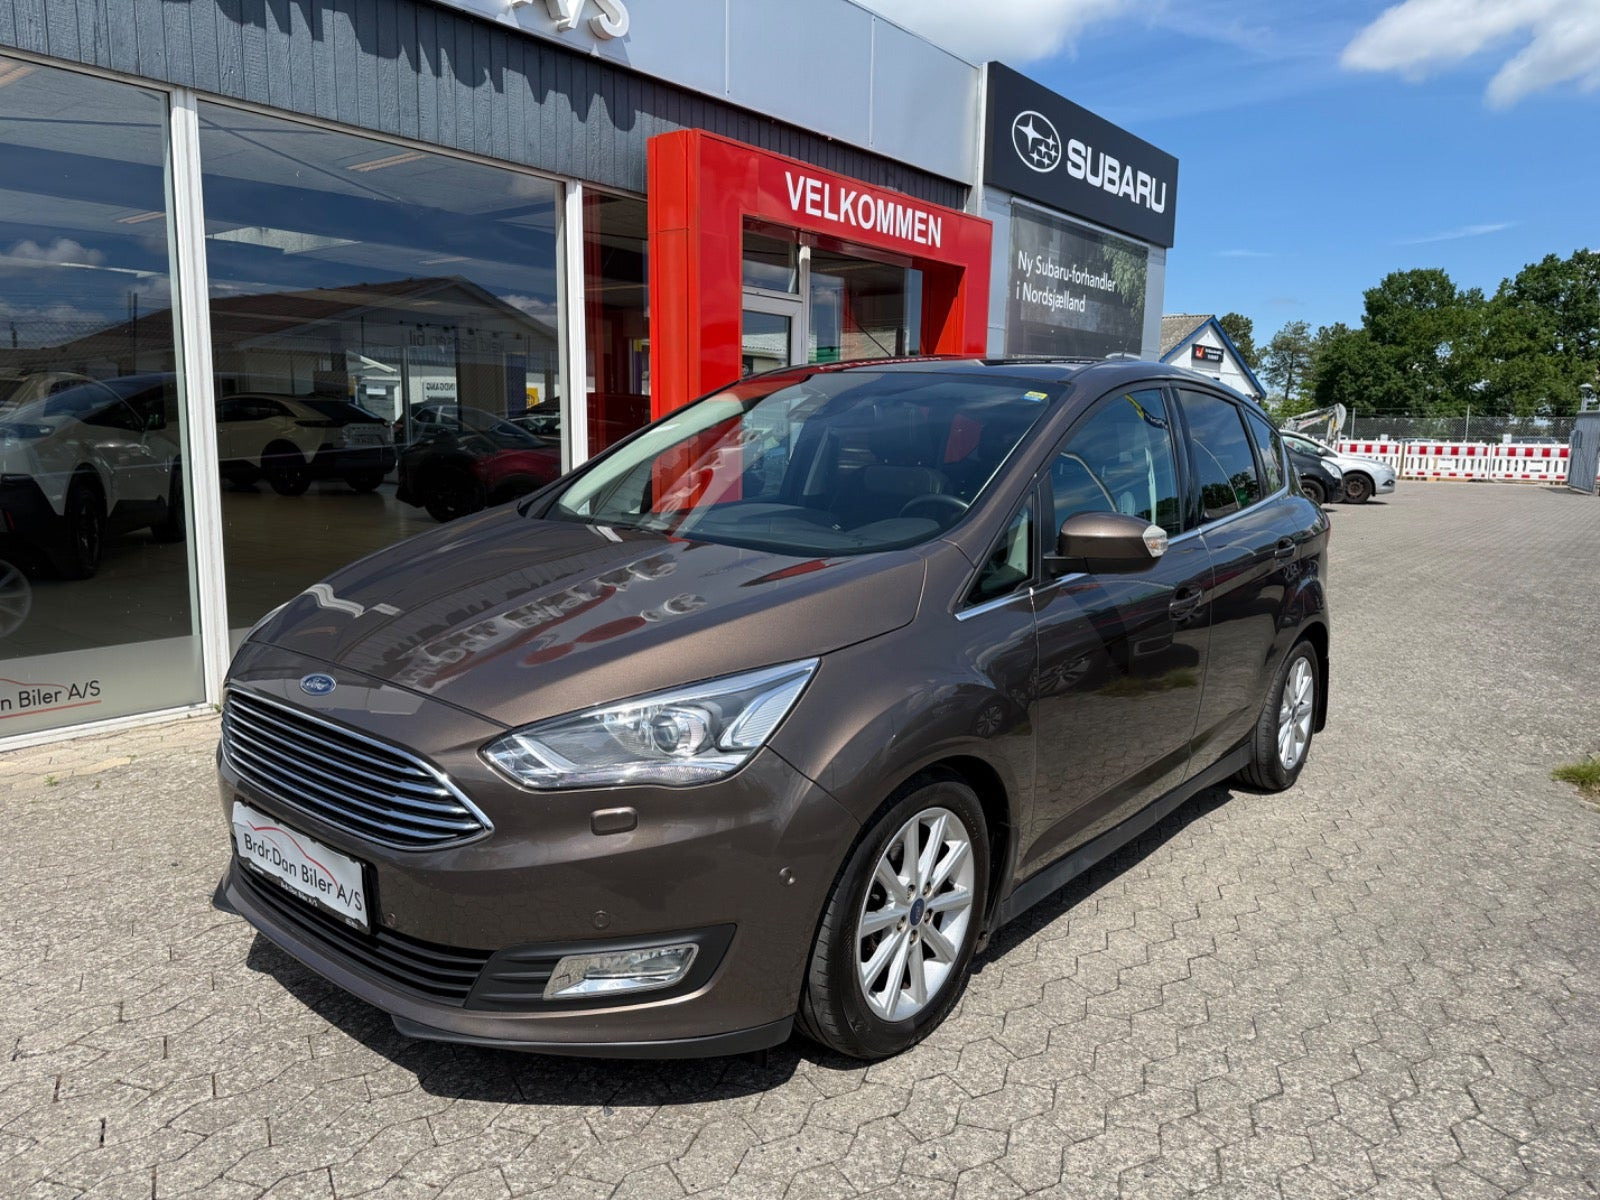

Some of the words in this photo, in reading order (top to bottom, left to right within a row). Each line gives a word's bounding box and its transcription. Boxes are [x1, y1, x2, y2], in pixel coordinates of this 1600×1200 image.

[1067, 138, 1166, 214] SUBARU
[785, 171, 942, 248] VELKOMMEN
[1016, 281, 1020, 300] i
[1022, 282, 1086, 313] Nordsjælland
[1017, 250, 1033, 277] Ny
[1035, 255, 1117, 292] Subaru-forhandler
[18, 688, 62, 708] Biler
[67, 680, 101, 700] A/S
[243, 832, 297, 877] Brdr.Dan
[301, 863, 333, 895] Biler
[336, 883, 363, 912] A/S
